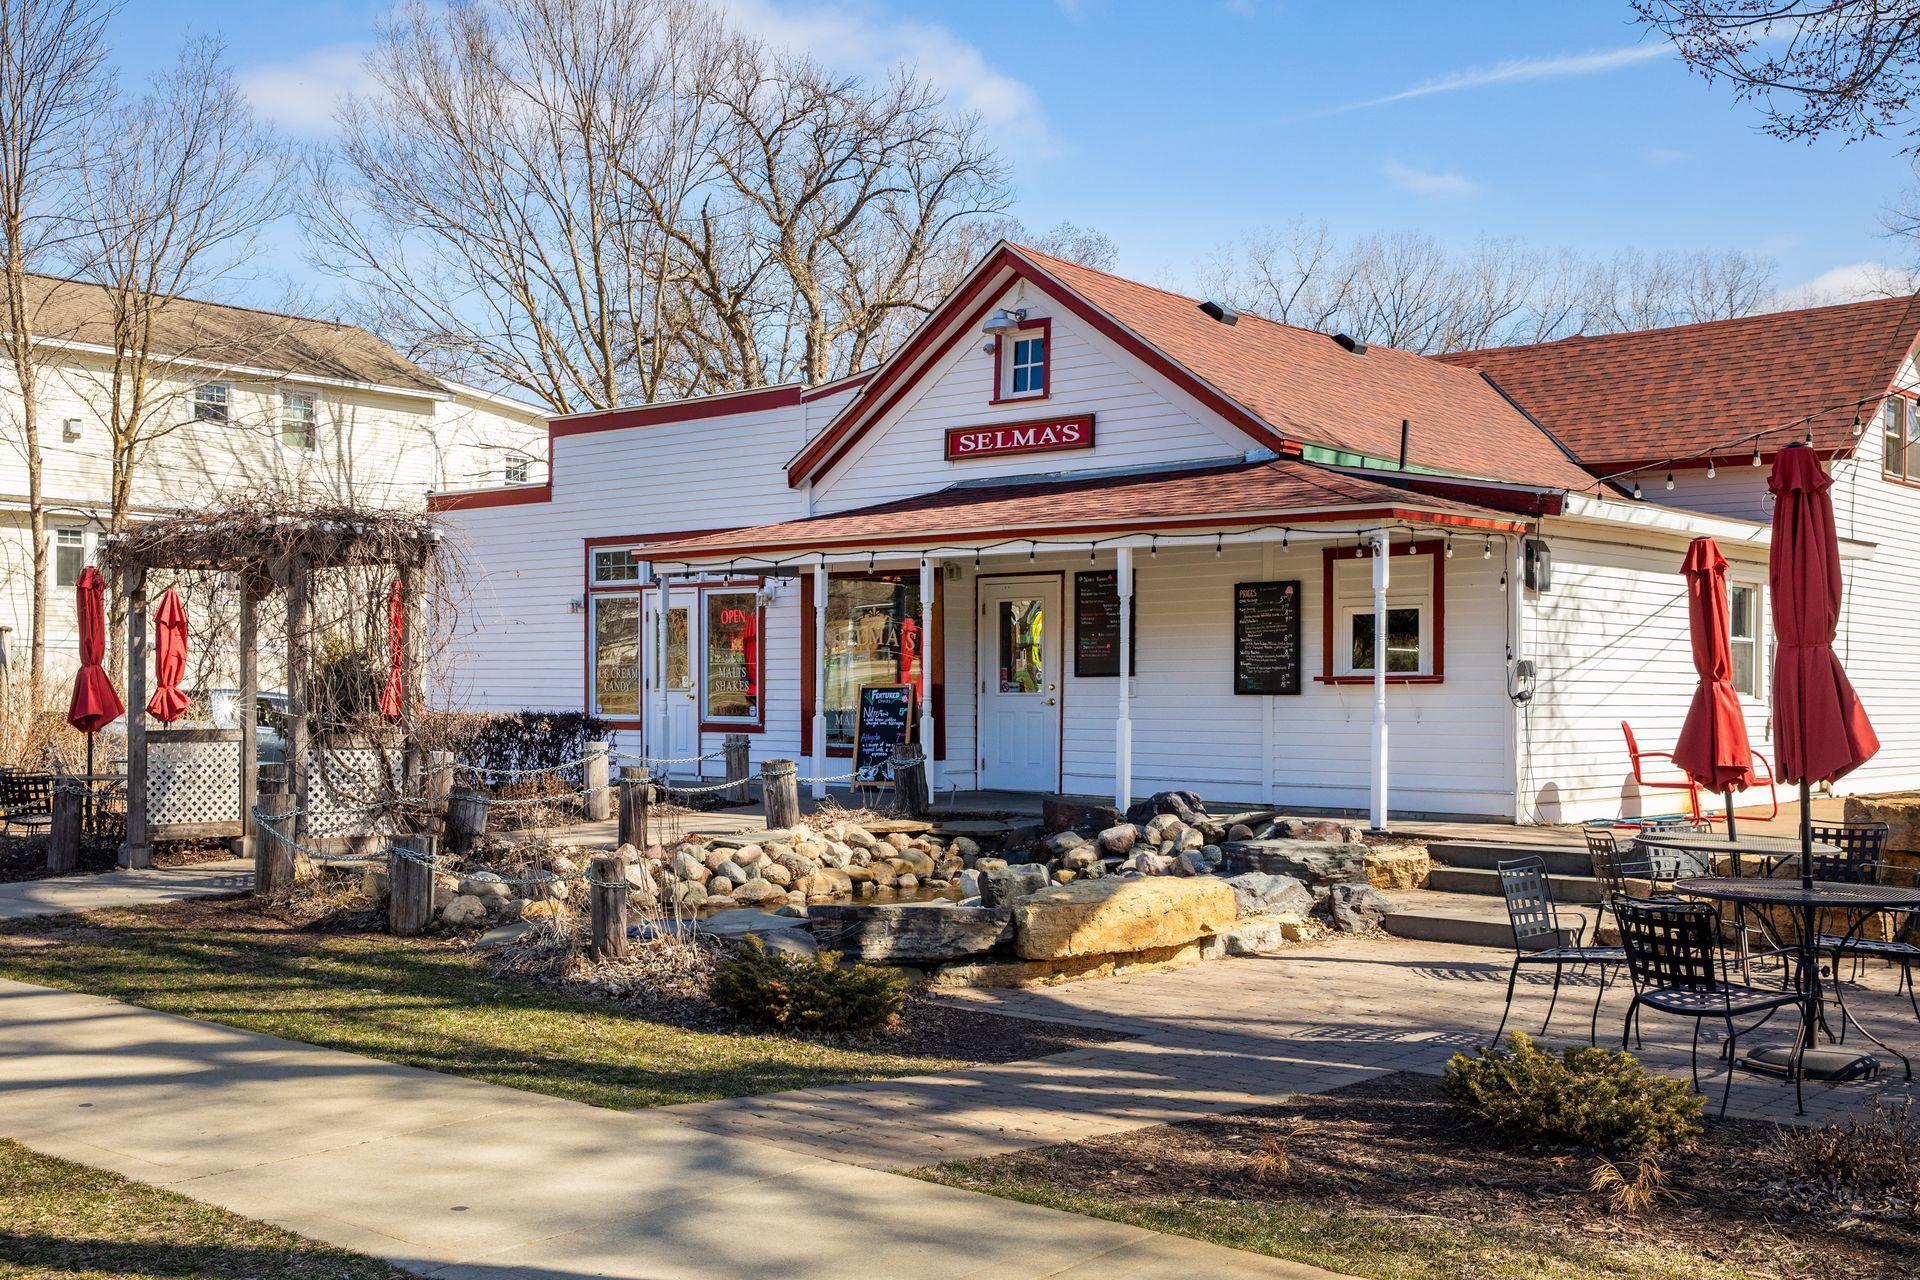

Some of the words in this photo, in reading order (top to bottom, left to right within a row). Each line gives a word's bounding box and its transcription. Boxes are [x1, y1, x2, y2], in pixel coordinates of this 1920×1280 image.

[959, 423, 1081, 452] SELMA'S
[720, 608, 746, 624] OPEN
[834, 626, 917, 650] SLMA'S
[610, 668, 638, 679] CREAM
[718, 666, 747, 678] MALTS
[604, 681, 631, 692] CANDY
[715, 680, 750, 692] SHAKES
